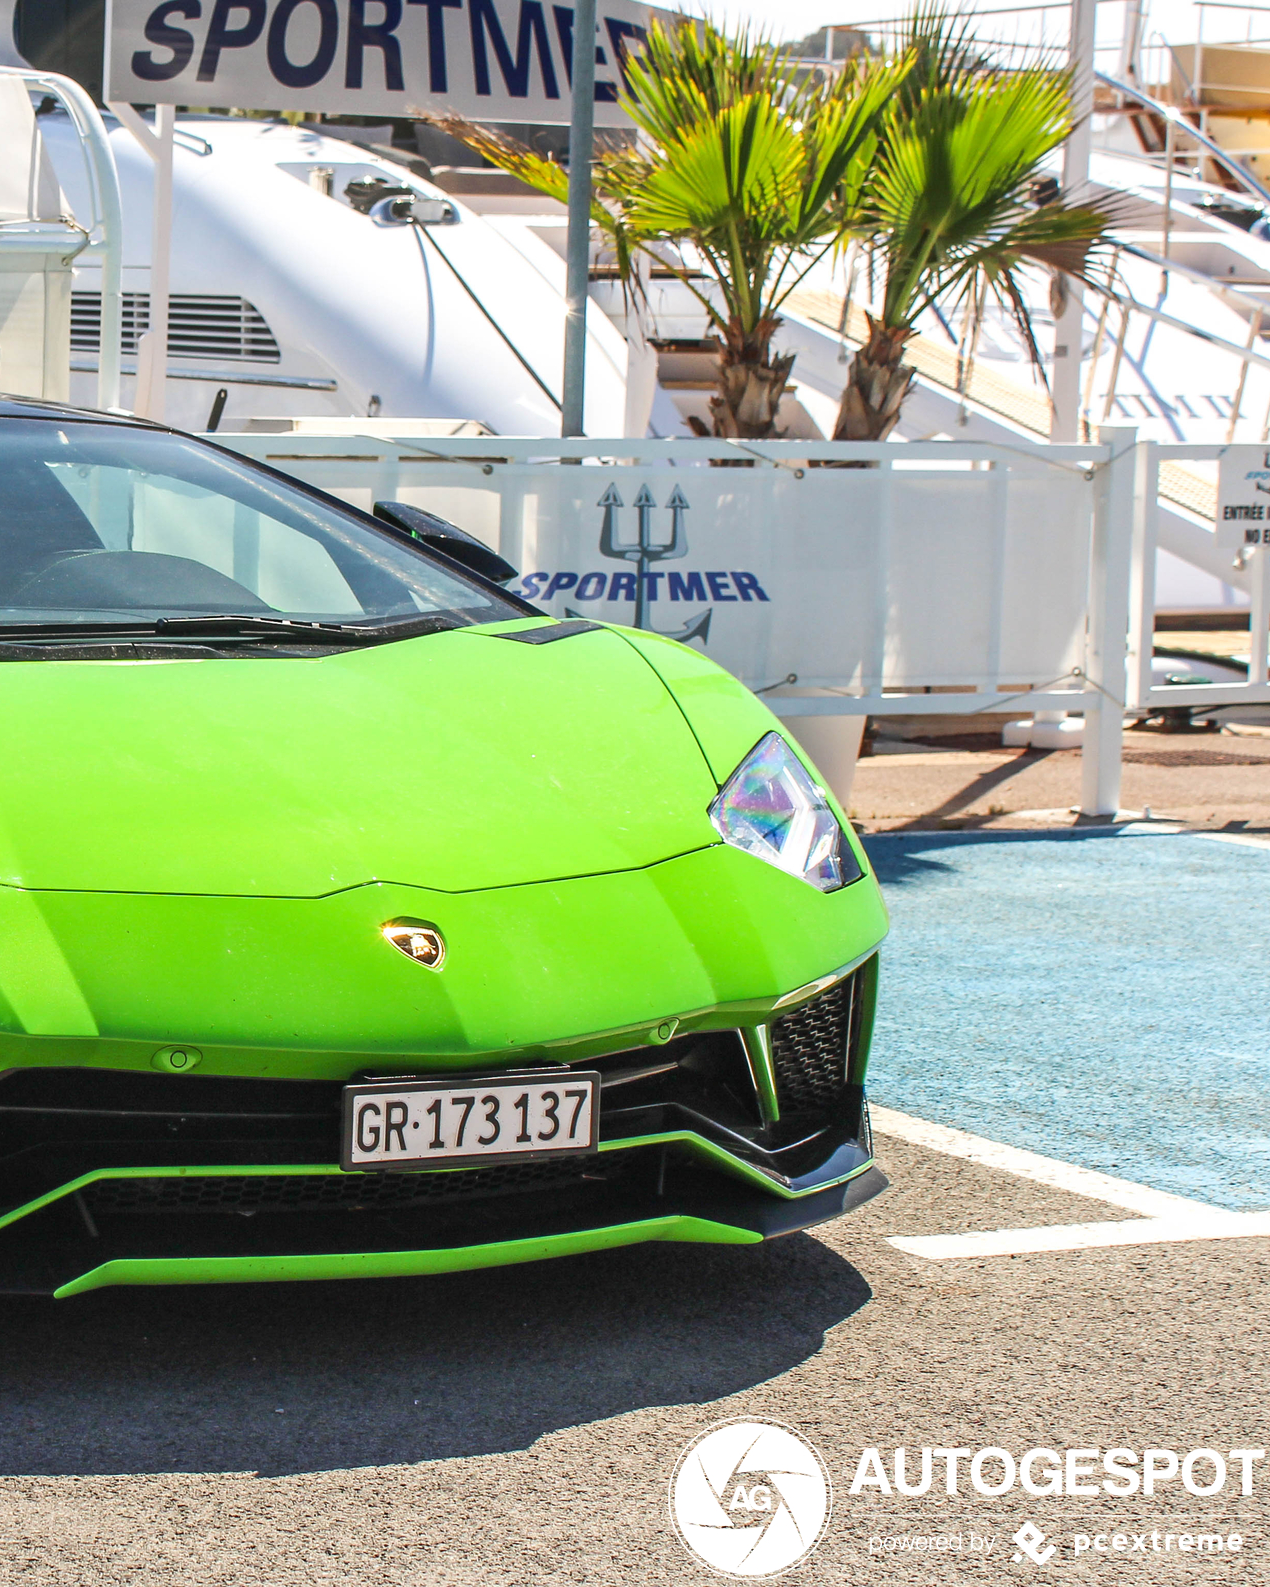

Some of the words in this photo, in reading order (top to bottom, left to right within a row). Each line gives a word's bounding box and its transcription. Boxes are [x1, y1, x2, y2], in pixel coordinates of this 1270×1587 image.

[1223, 502, 1264, 520] ENTRÉE
[1245, 529, 1260, 543] NO
[514, 571, 771, 602] SPORTMER
[513, 1089, 589, 1143] 137
